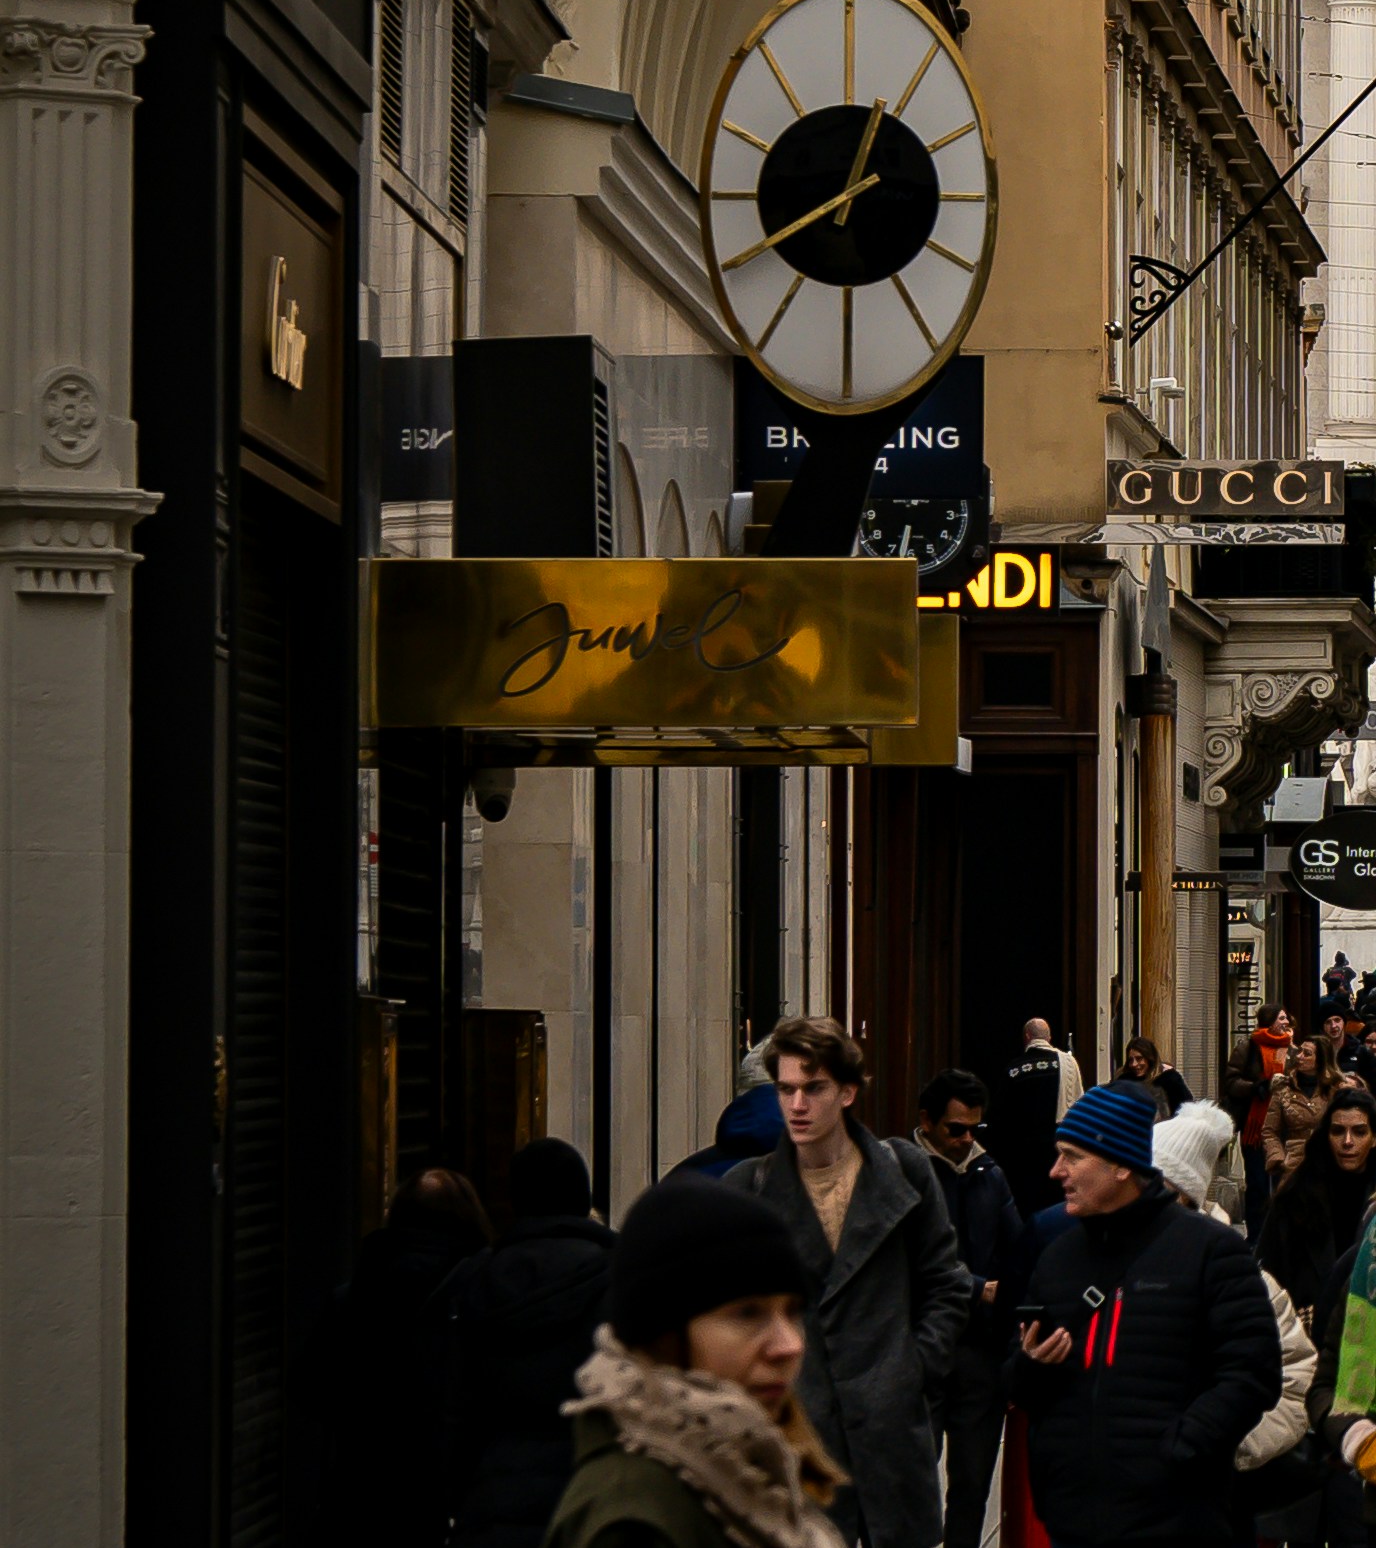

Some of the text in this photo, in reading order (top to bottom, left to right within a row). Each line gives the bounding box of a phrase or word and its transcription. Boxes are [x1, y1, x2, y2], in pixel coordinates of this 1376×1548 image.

[1119, 470, 1333, 505] GUCCI
[501, 588, 788, 698] Juwel
[1300, 839, 1340, 867] GS
